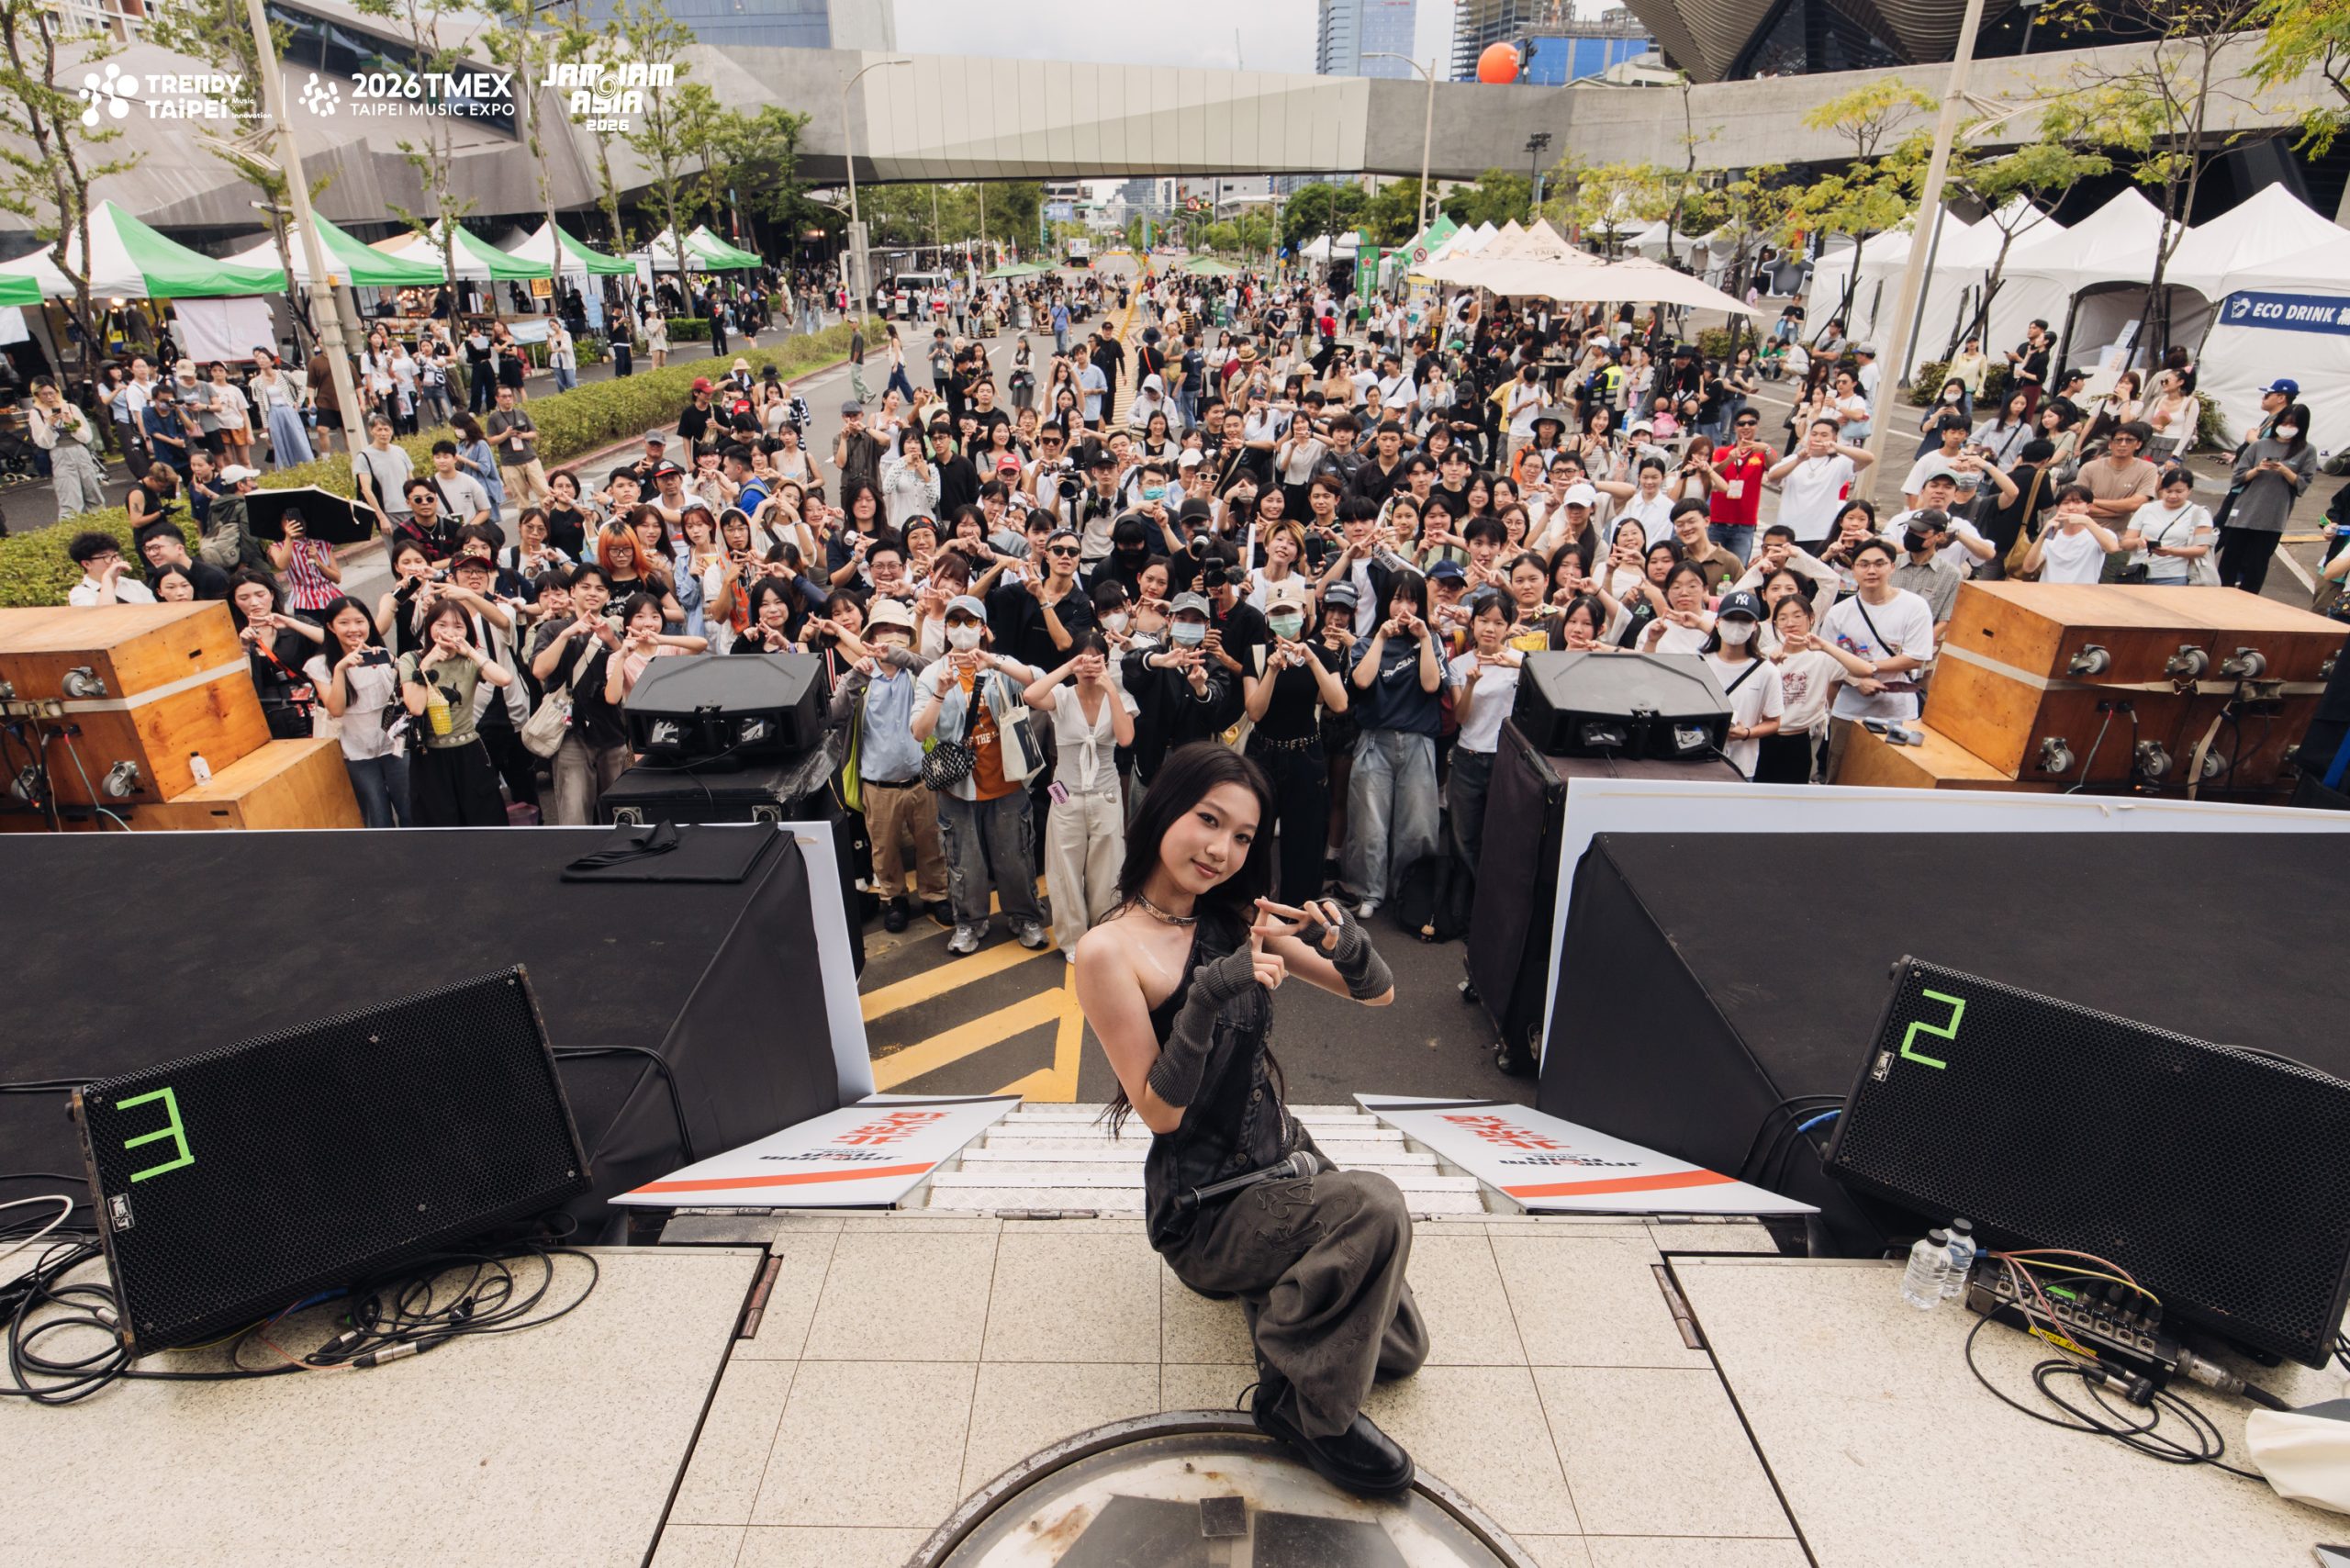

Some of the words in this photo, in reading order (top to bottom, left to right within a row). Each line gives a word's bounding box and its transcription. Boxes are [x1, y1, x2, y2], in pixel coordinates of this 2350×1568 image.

[2252, 302, 2284, 319] ECO
[2285, 305, 2337, 322] DRINK
[1735, 593, 1750, 606] NY
[975, 733, 991, 745] THE
[1900, 989, 1966, 1070] 2
[116, 1086, 196, 1183] 3
[111, 1195, 130, 1229] NEXT
